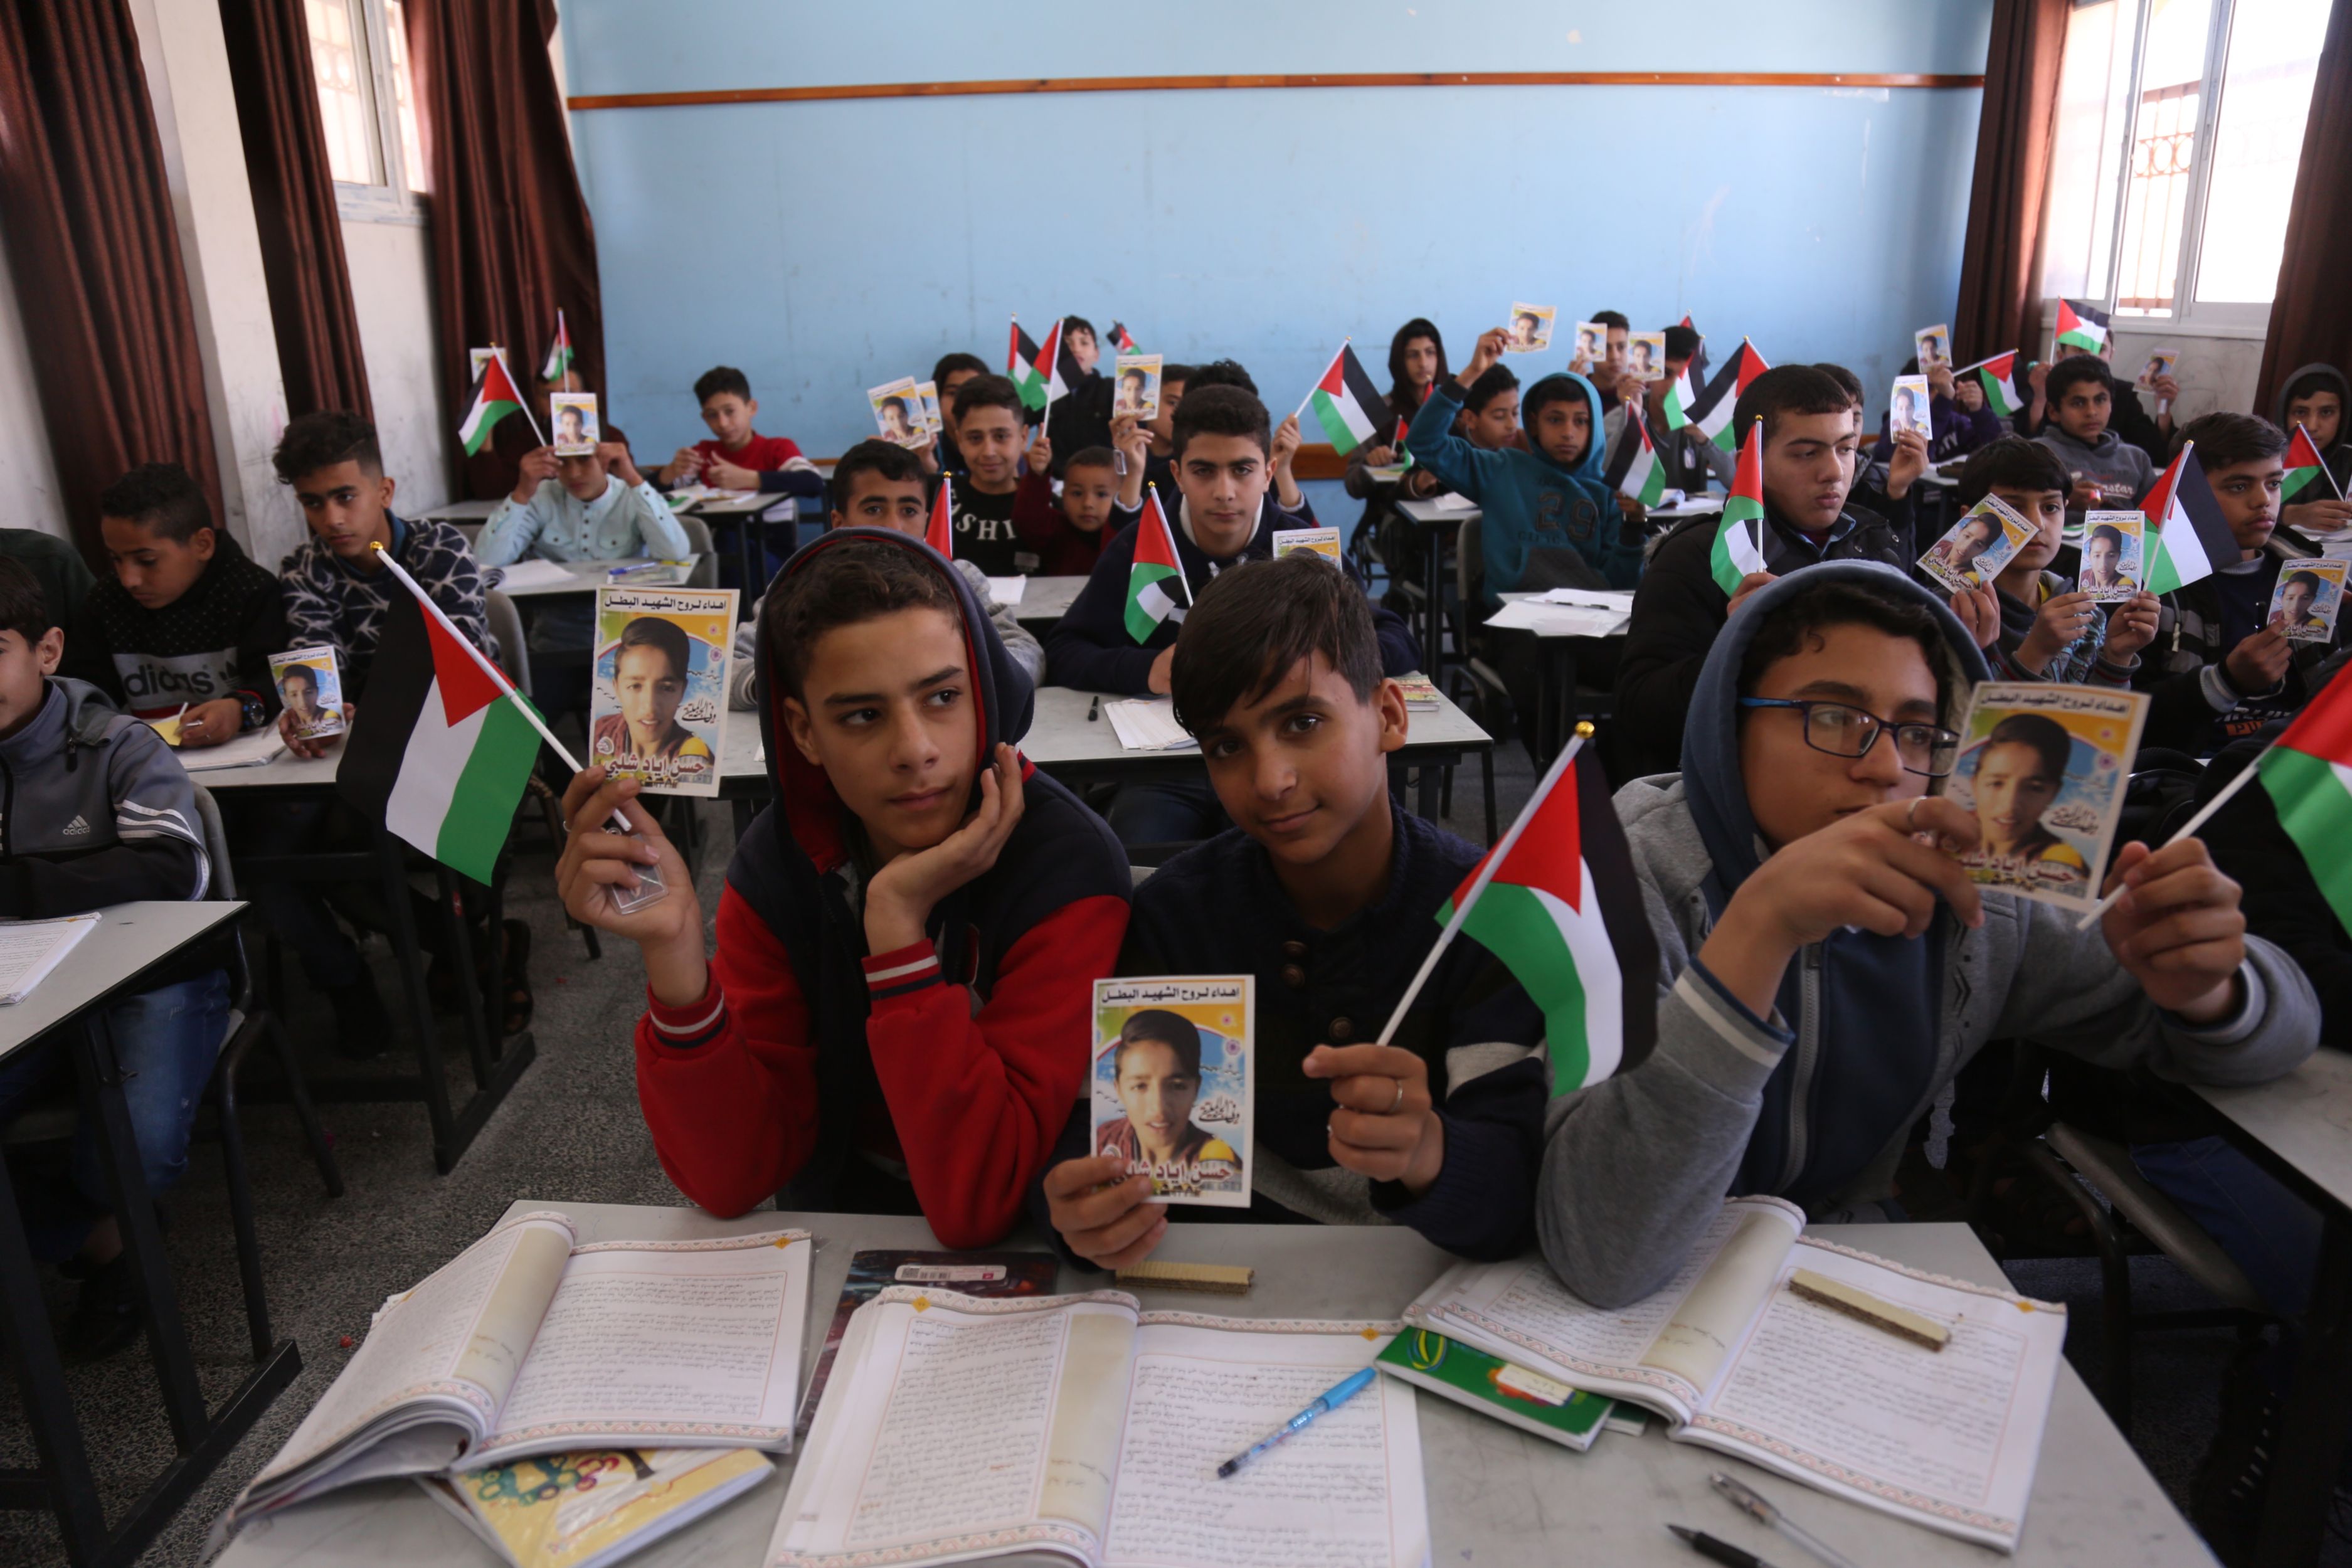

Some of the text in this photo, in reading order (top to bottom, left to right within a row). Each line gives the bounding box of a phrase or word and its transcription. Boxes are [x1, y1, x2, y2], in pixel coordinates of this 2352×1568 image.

[1536, 491, 1598, 544] 29
[605, 596, 639, 609] البطل
[642, 596, 675, 610] الشهيد
[677, 599, 702, 611] لروح
[605, 755, 638, 778] شلبي
[670, 760, 704, 777] حسن
[1102, 988, 1140, 1003] البطل
[1142, 986, 1180, 1001] الشهيد
[1182, 987, 1209, 1001] لروح
[1190, 1165, 1231, 1184] حسن
